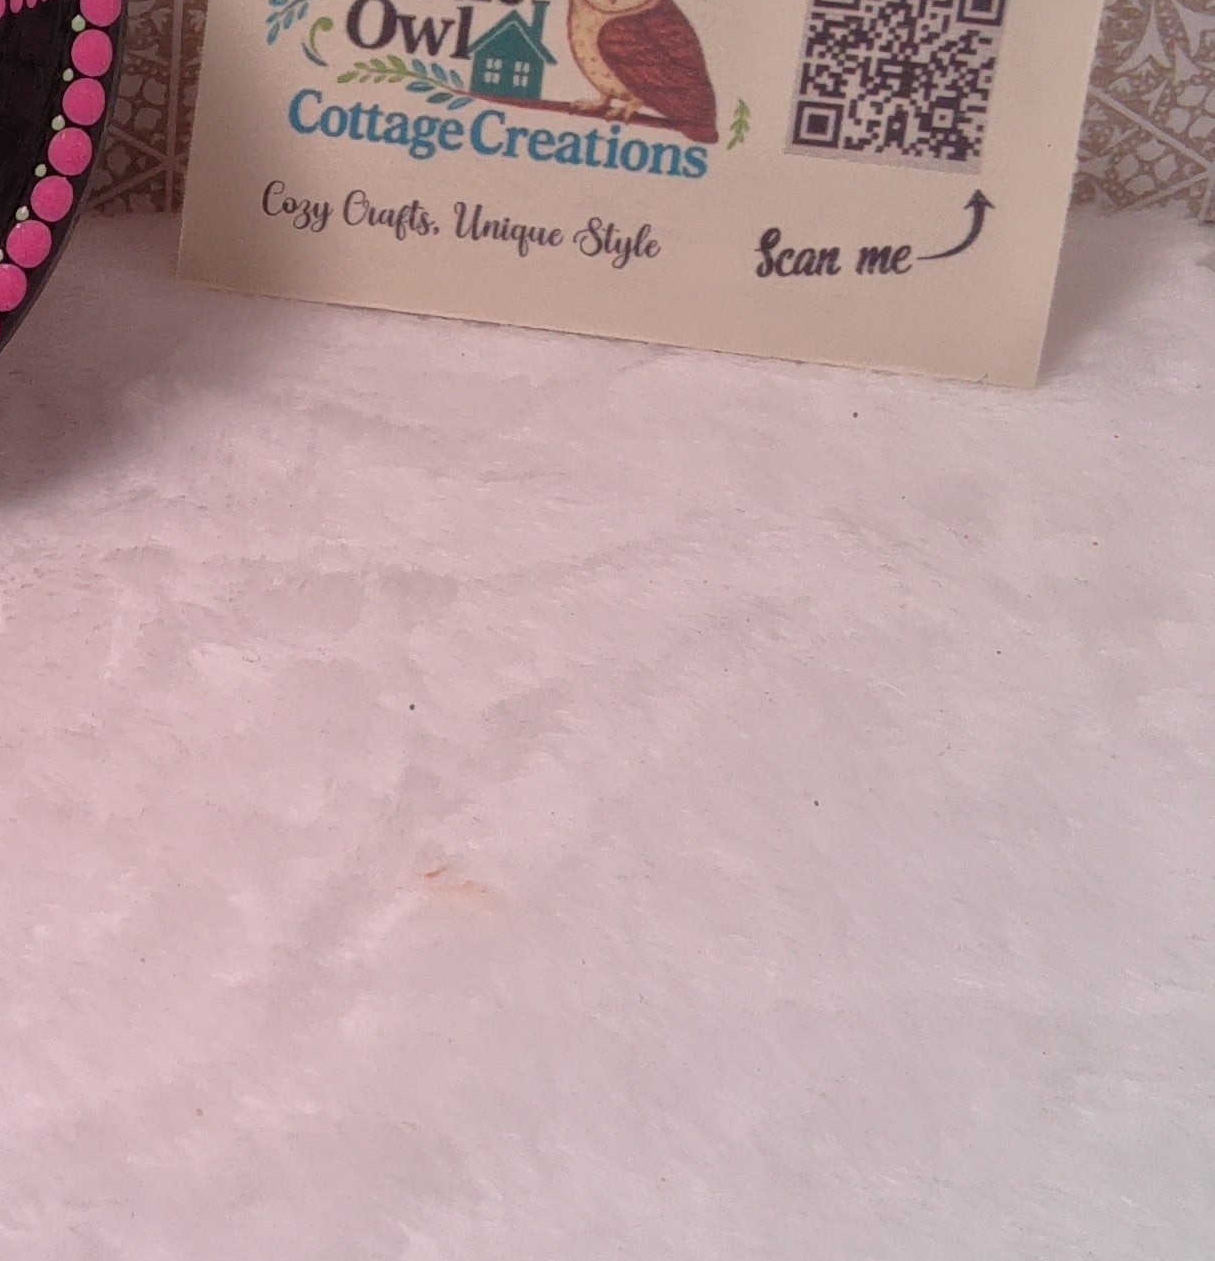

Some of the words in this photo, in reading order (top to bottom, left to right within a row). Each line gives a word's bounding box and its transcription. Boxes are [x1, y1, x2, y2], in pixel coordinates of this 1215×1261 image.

[288, 89, 464, 160] Cottage
[470, 110, 709, 178] Creations
[262, 180, 332, 232] Cozy
[343, 189, 440, 240] Crafts,
[454, 202, 563, 258] Unique
[573, 217, 661, 269] Style
[755, 228, 842, 278] Scan
[856, 244, 912, 275] me
